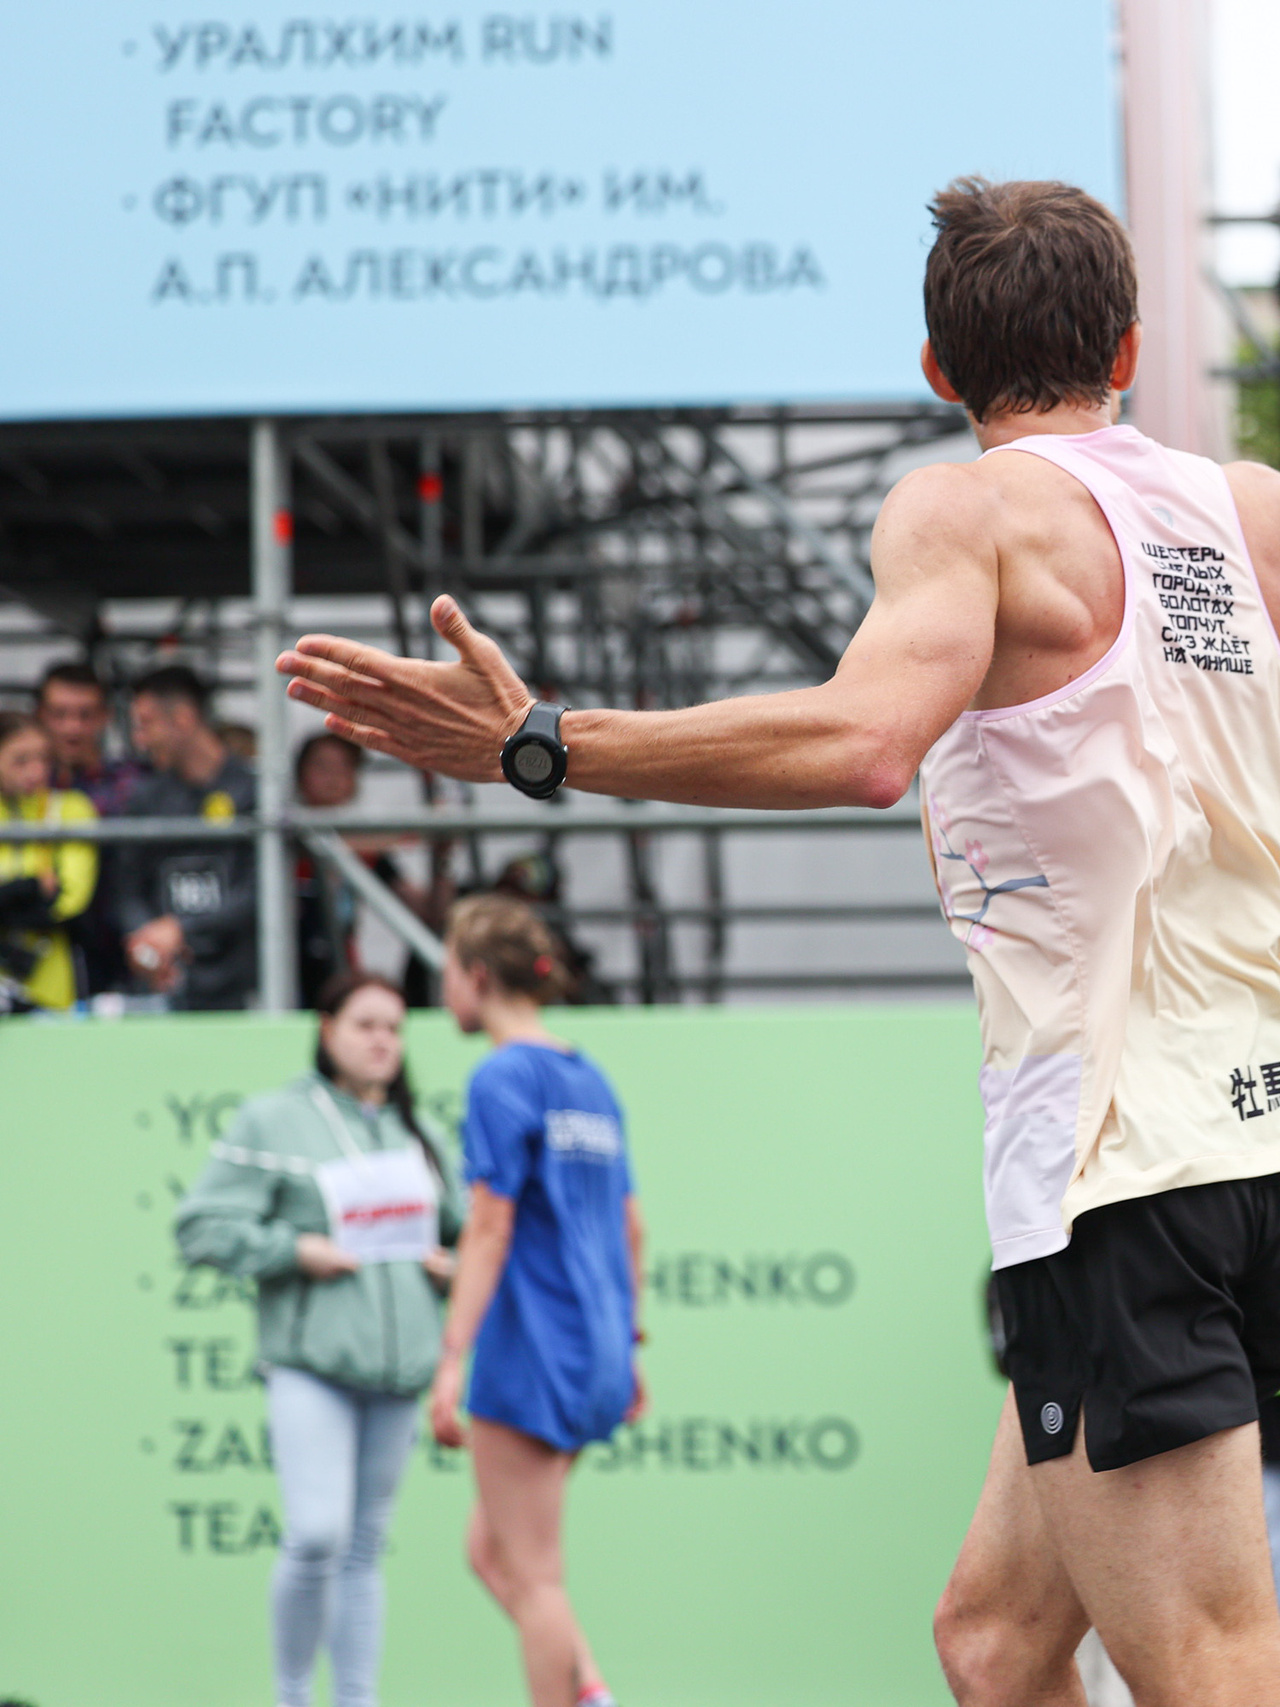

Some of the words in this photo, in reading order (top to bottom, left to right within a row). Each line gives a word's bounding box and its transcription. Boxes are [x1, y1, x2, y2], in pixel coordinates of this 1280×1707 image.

[153, 18, 466, 74] УРАЛХИМ
[481, 12, 614, 65] RUN
[165, 92, 448, 150] FACTORY
[152, 172, 328, 232] ФГУП
[293, 241, 828, 306] АЛЕКСАНДРОВА
[1158, 593, 1234, 617] БОЛОТАХ
[1168, 613, 1230, 635] ТОПЧУТ.
[1163, 647, 1187, 664] НА
[1190, 654, 1254, 675] ИНИШЕ
